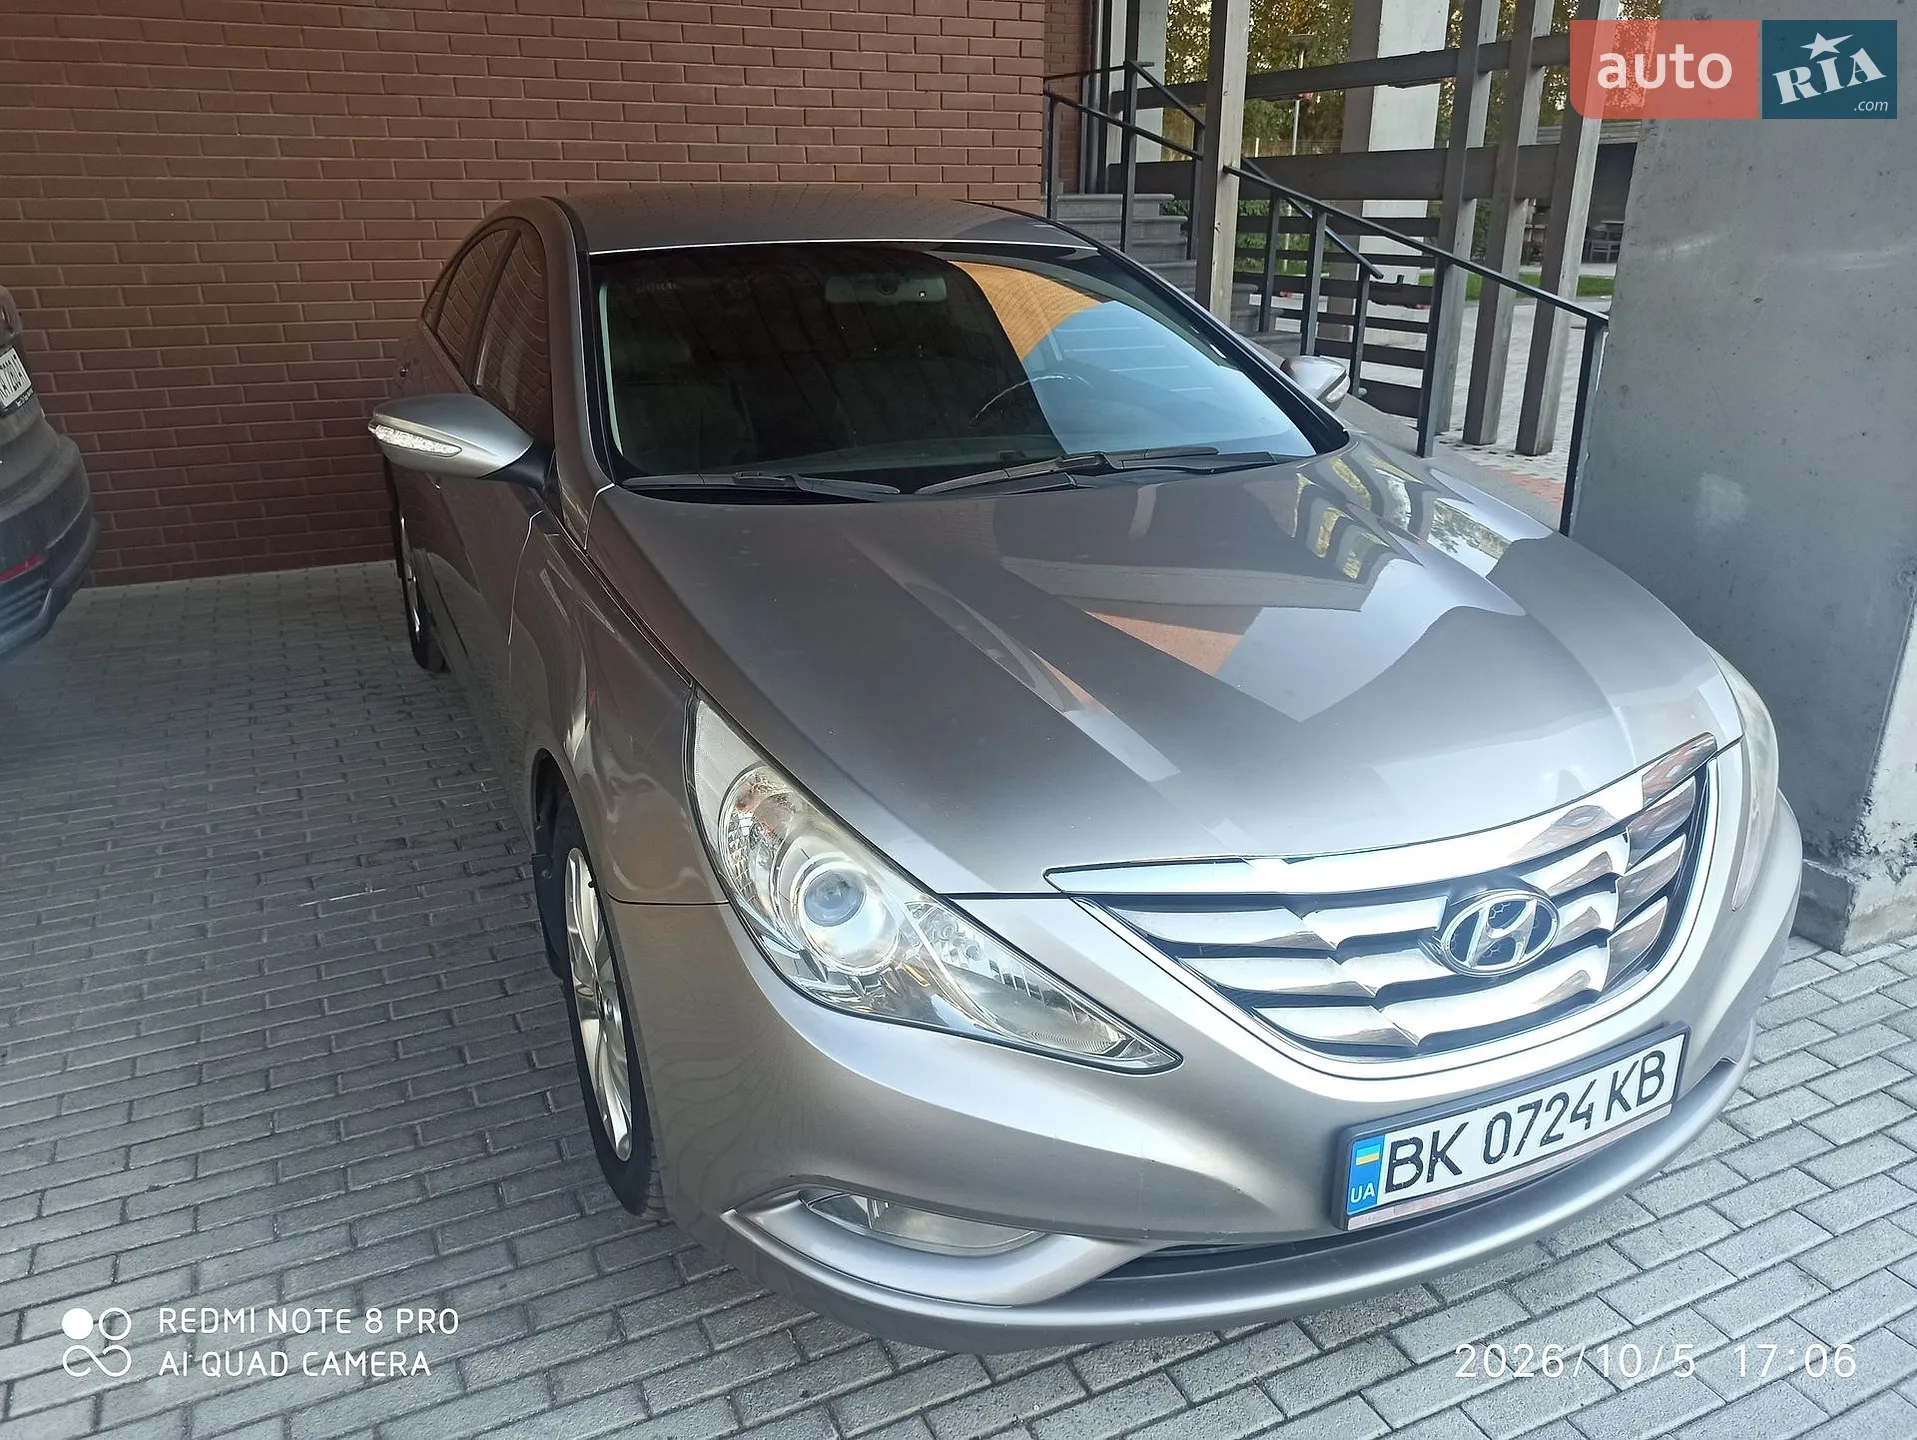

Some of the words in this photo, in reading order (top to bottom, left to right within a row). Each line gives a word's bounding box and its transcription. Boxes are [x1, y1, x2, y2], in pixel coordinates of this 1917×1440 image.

[1384, 1121, 1470, 1194] BK
[1481, 1079, 1597, 1165] 0724
[1604, 1049, 1665, 1122] KB
[1350, 1182, 1376, 1203] UA
